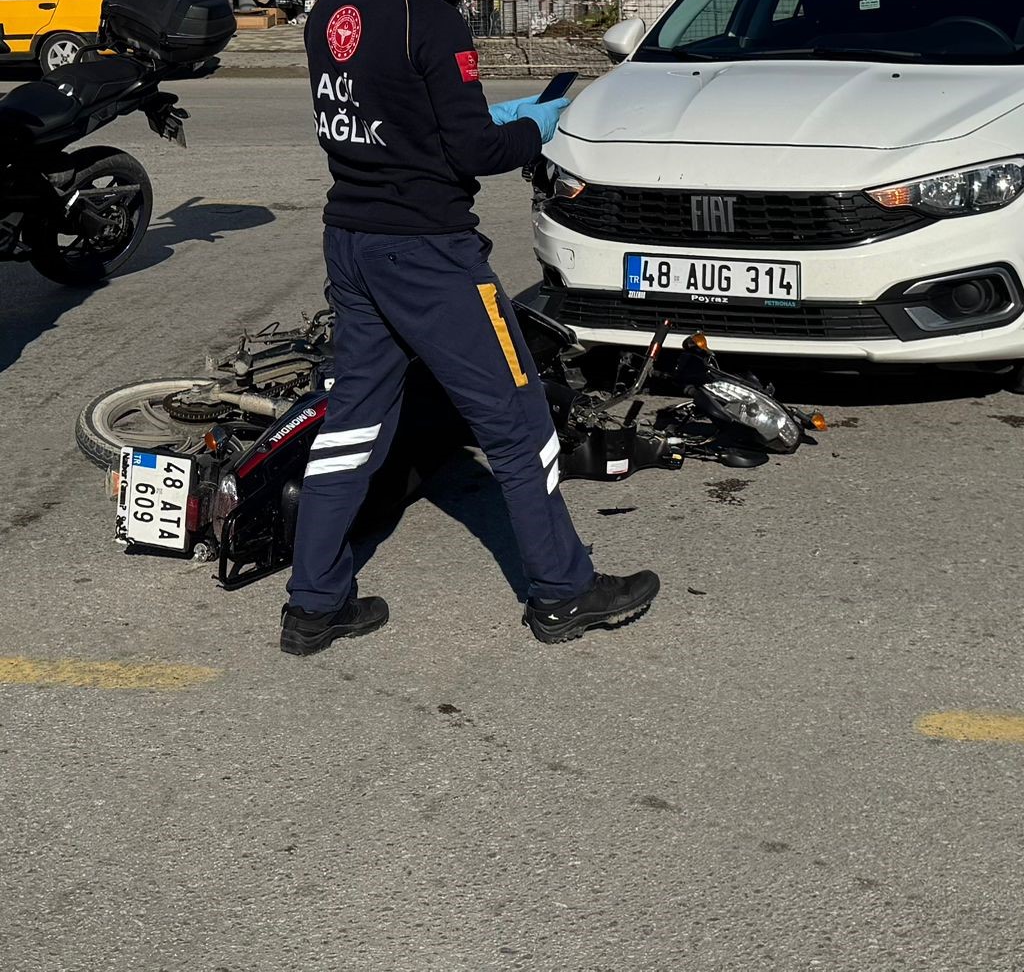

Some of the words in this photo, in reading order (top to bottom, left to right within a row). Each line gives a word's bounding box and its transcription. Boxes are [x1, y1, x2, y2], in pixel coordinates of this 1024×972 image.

[313, 108, 386, 146] AĞLIK
[691, 195, 736, 232] FIAT
[629, 275, 640, 283] TR
[642, 260, 671, 288] 48
[686, 262, 731, 292] AUG
[746, 266, 793, 295] 314
[691, 294, 729, 304] Poyraz
[269, 413, 308, 443] MONDIAL
[133, 455, 141, 465] TR
[163, 462, 185, 489] 48
[133, 483, 156, 523] 609
[159, 500, 182, 539] ATA
